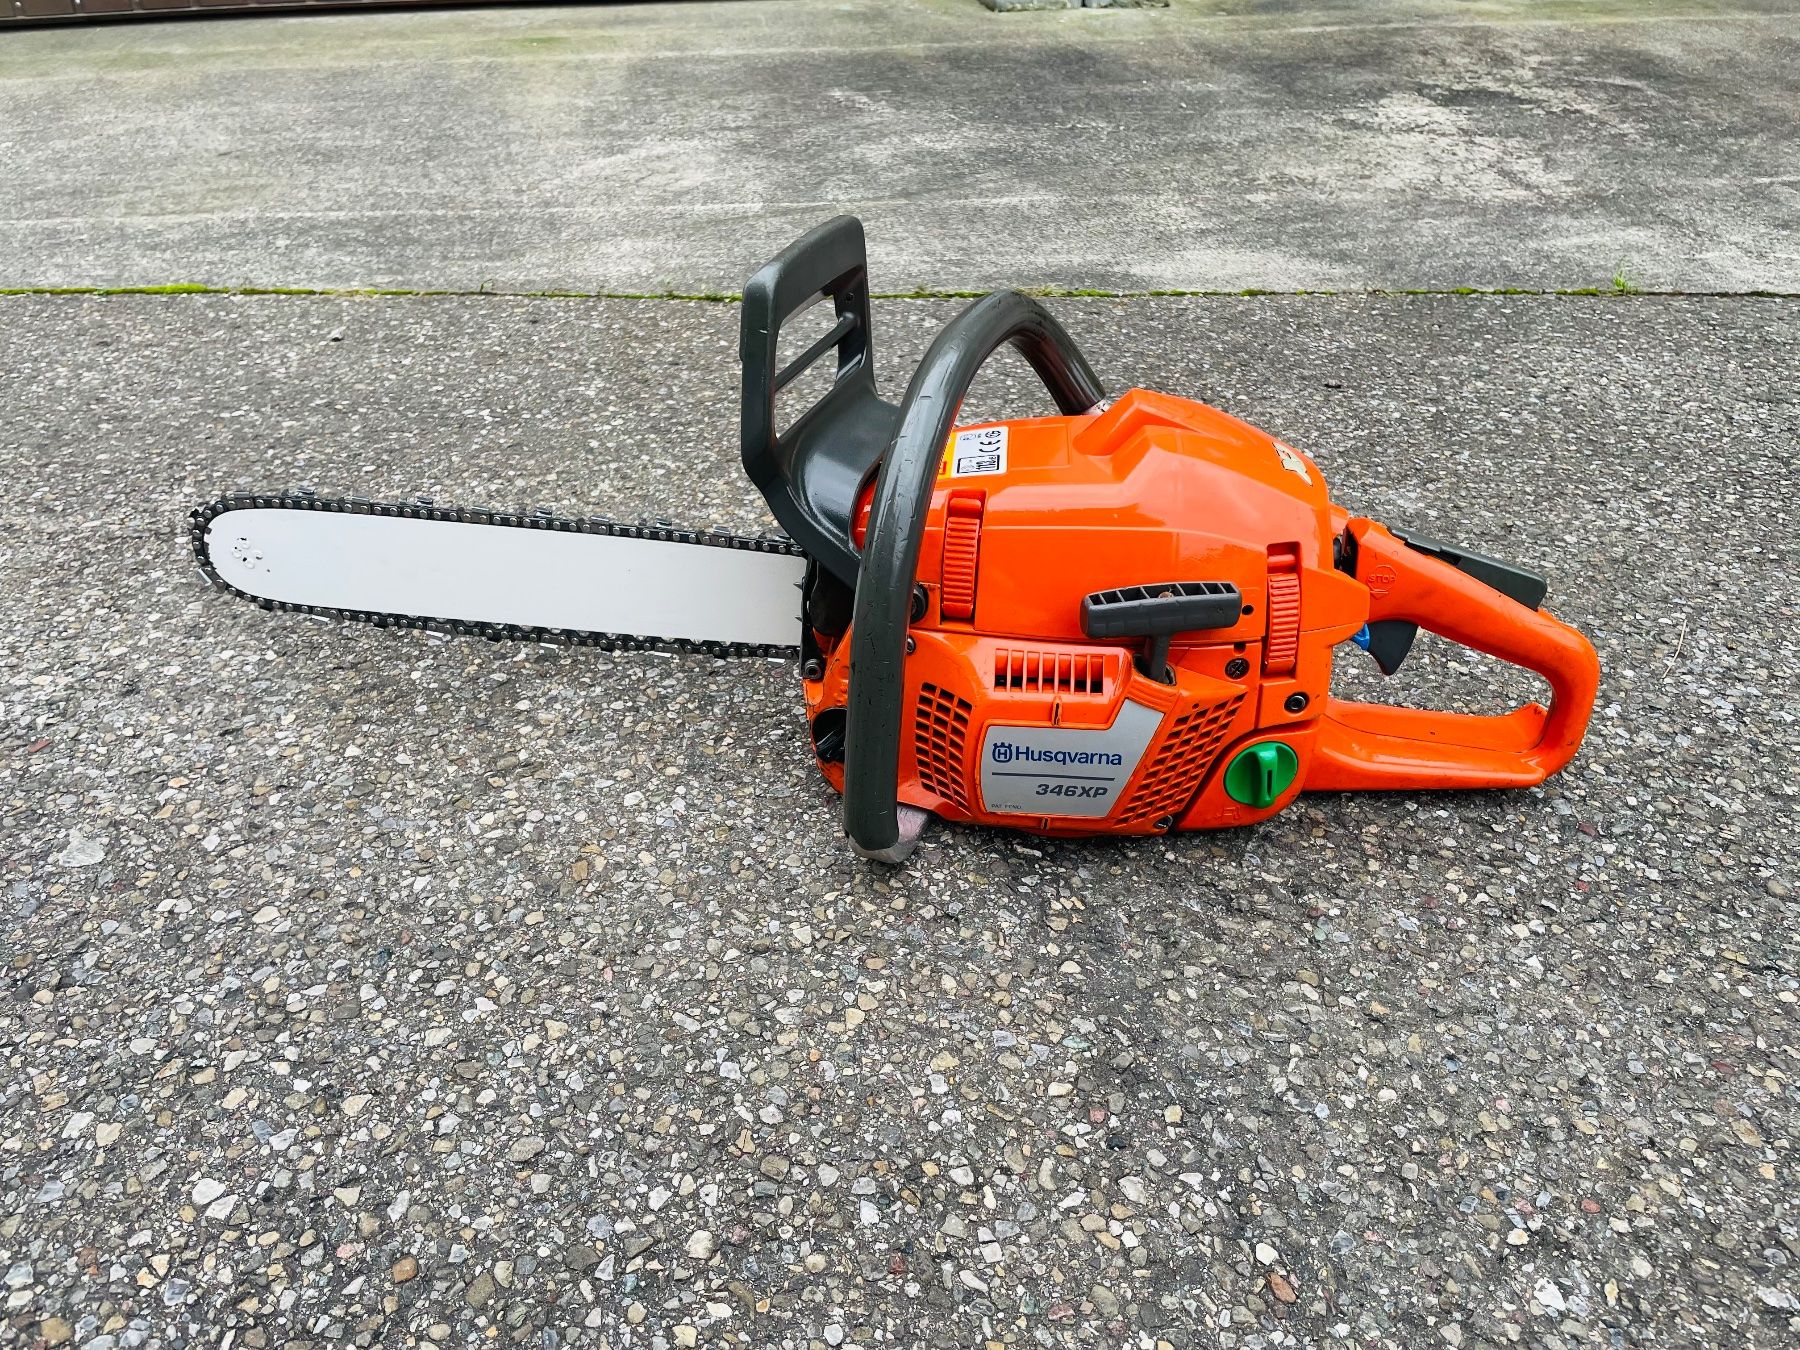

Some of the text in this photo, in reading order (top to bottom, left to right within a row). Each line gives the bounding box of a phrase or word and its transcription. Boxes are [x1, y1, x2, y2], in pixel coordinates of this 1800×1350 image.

[1368, 574, 1396, 583] STOP
[1015, 745, 1122, 765] Husqvarna
[1035, 783, 1108, 799] 346XP
